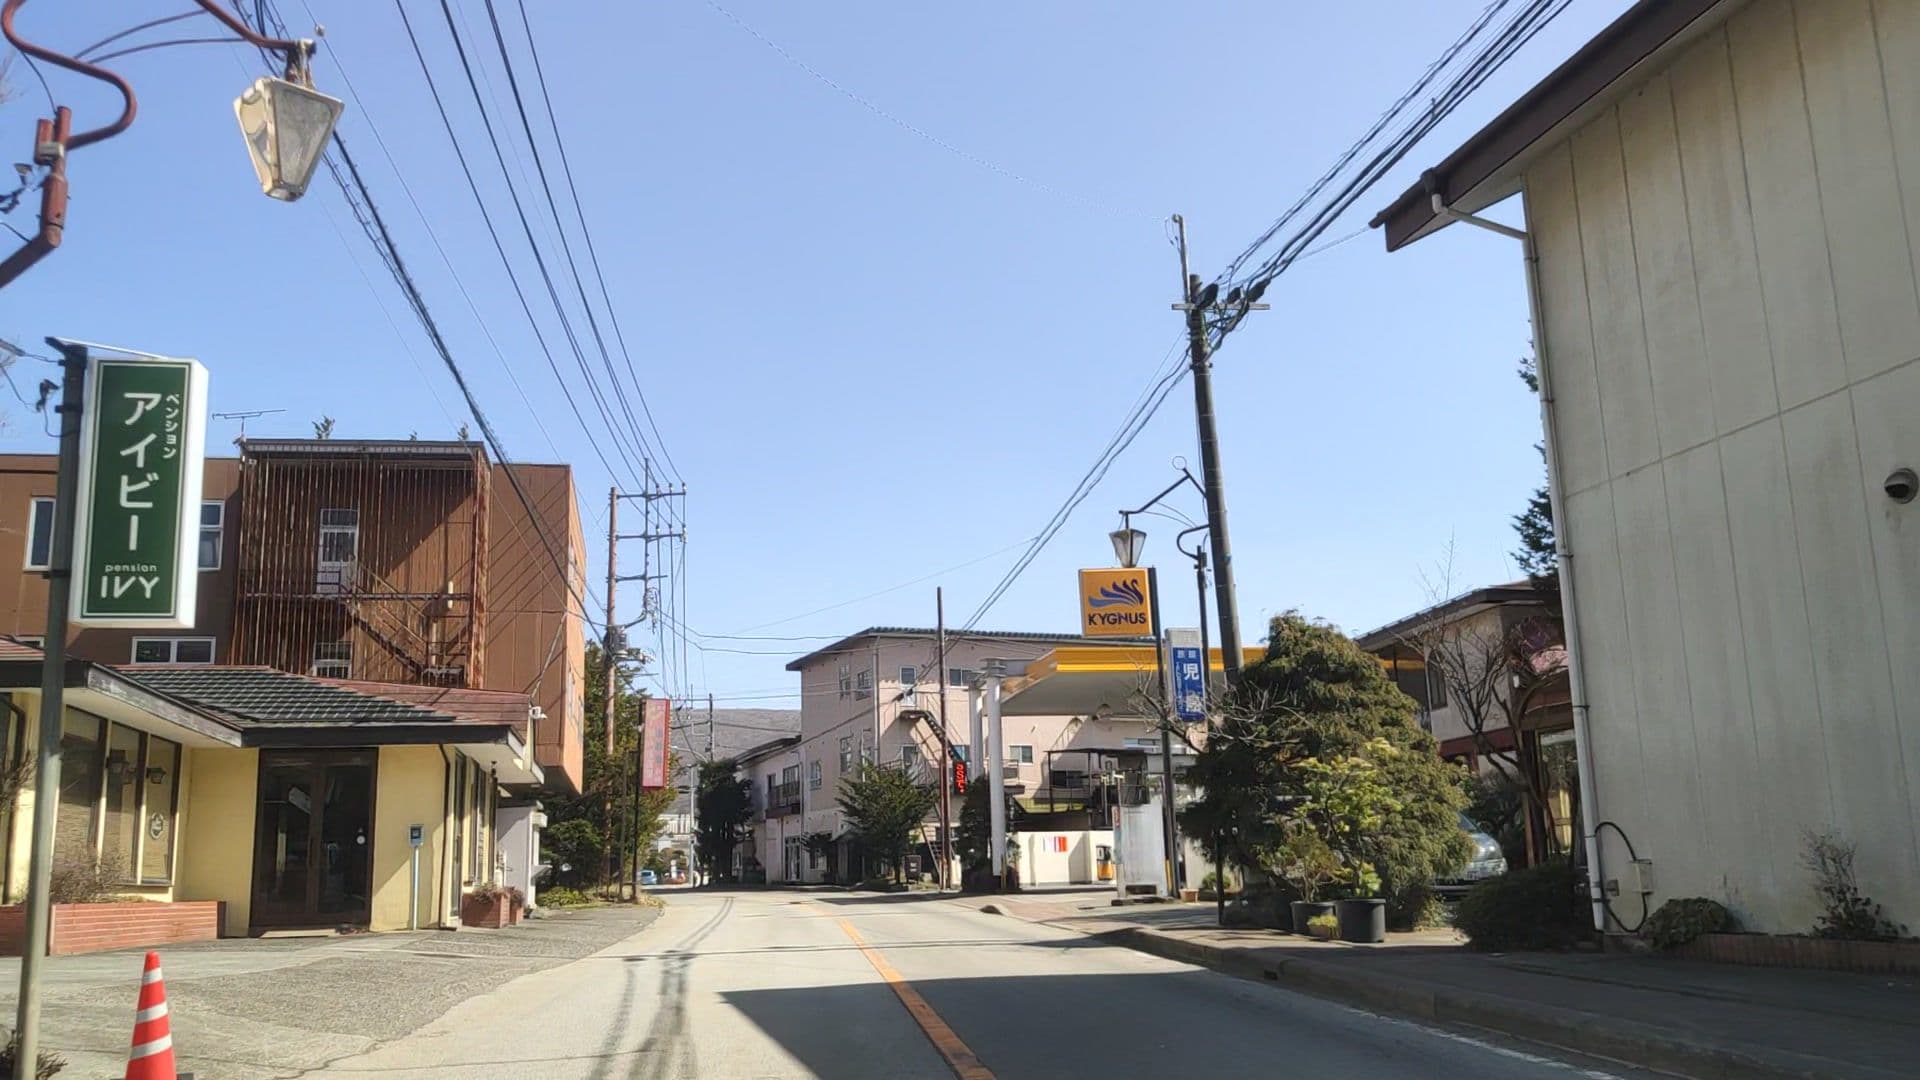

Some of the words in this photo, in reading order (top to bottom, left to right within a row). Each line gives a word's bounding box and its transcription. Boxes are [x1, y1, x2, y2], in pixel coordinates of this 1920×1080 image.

[163, 393, 180, 459] ペンション
[119, 393, 162, 551] アイビー
[105, 563, 157, 573] pension
[101, 576, 160, 599] IVY
[1088, 612, 1146, 626] KYGNUS
